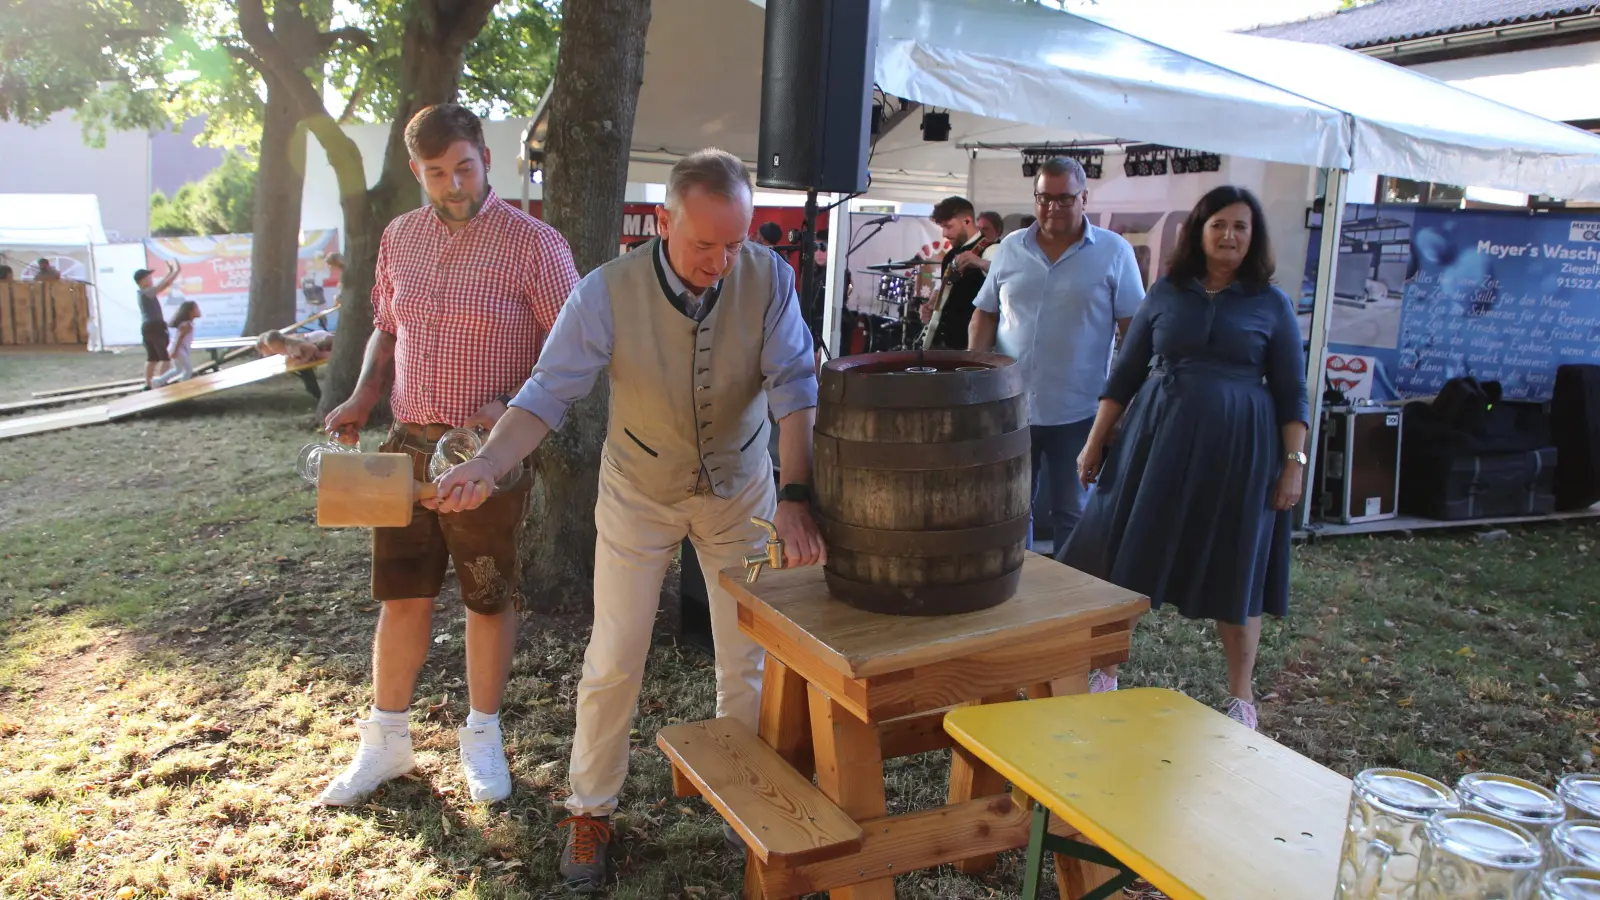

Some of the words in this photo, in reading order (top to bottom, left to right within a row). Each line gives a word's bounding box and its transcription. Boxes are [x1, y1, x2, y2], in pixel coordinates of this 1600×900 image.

[1557, 277, 1593, 290] 91522
[1471, 288, 1497, 303] Stille
[1495, 292, 1515, 309] für
[1519, 293, 1536, 306] den
[1514, 309, 1535, 325] für
[1448, 317, 1462, 330] der
[1530, 325, 1545, 337] der
[1561, 346, 1585, 357] wenn
[1420, 360, 1443, 372] dann
[1410, 373, 1424, 385] der
